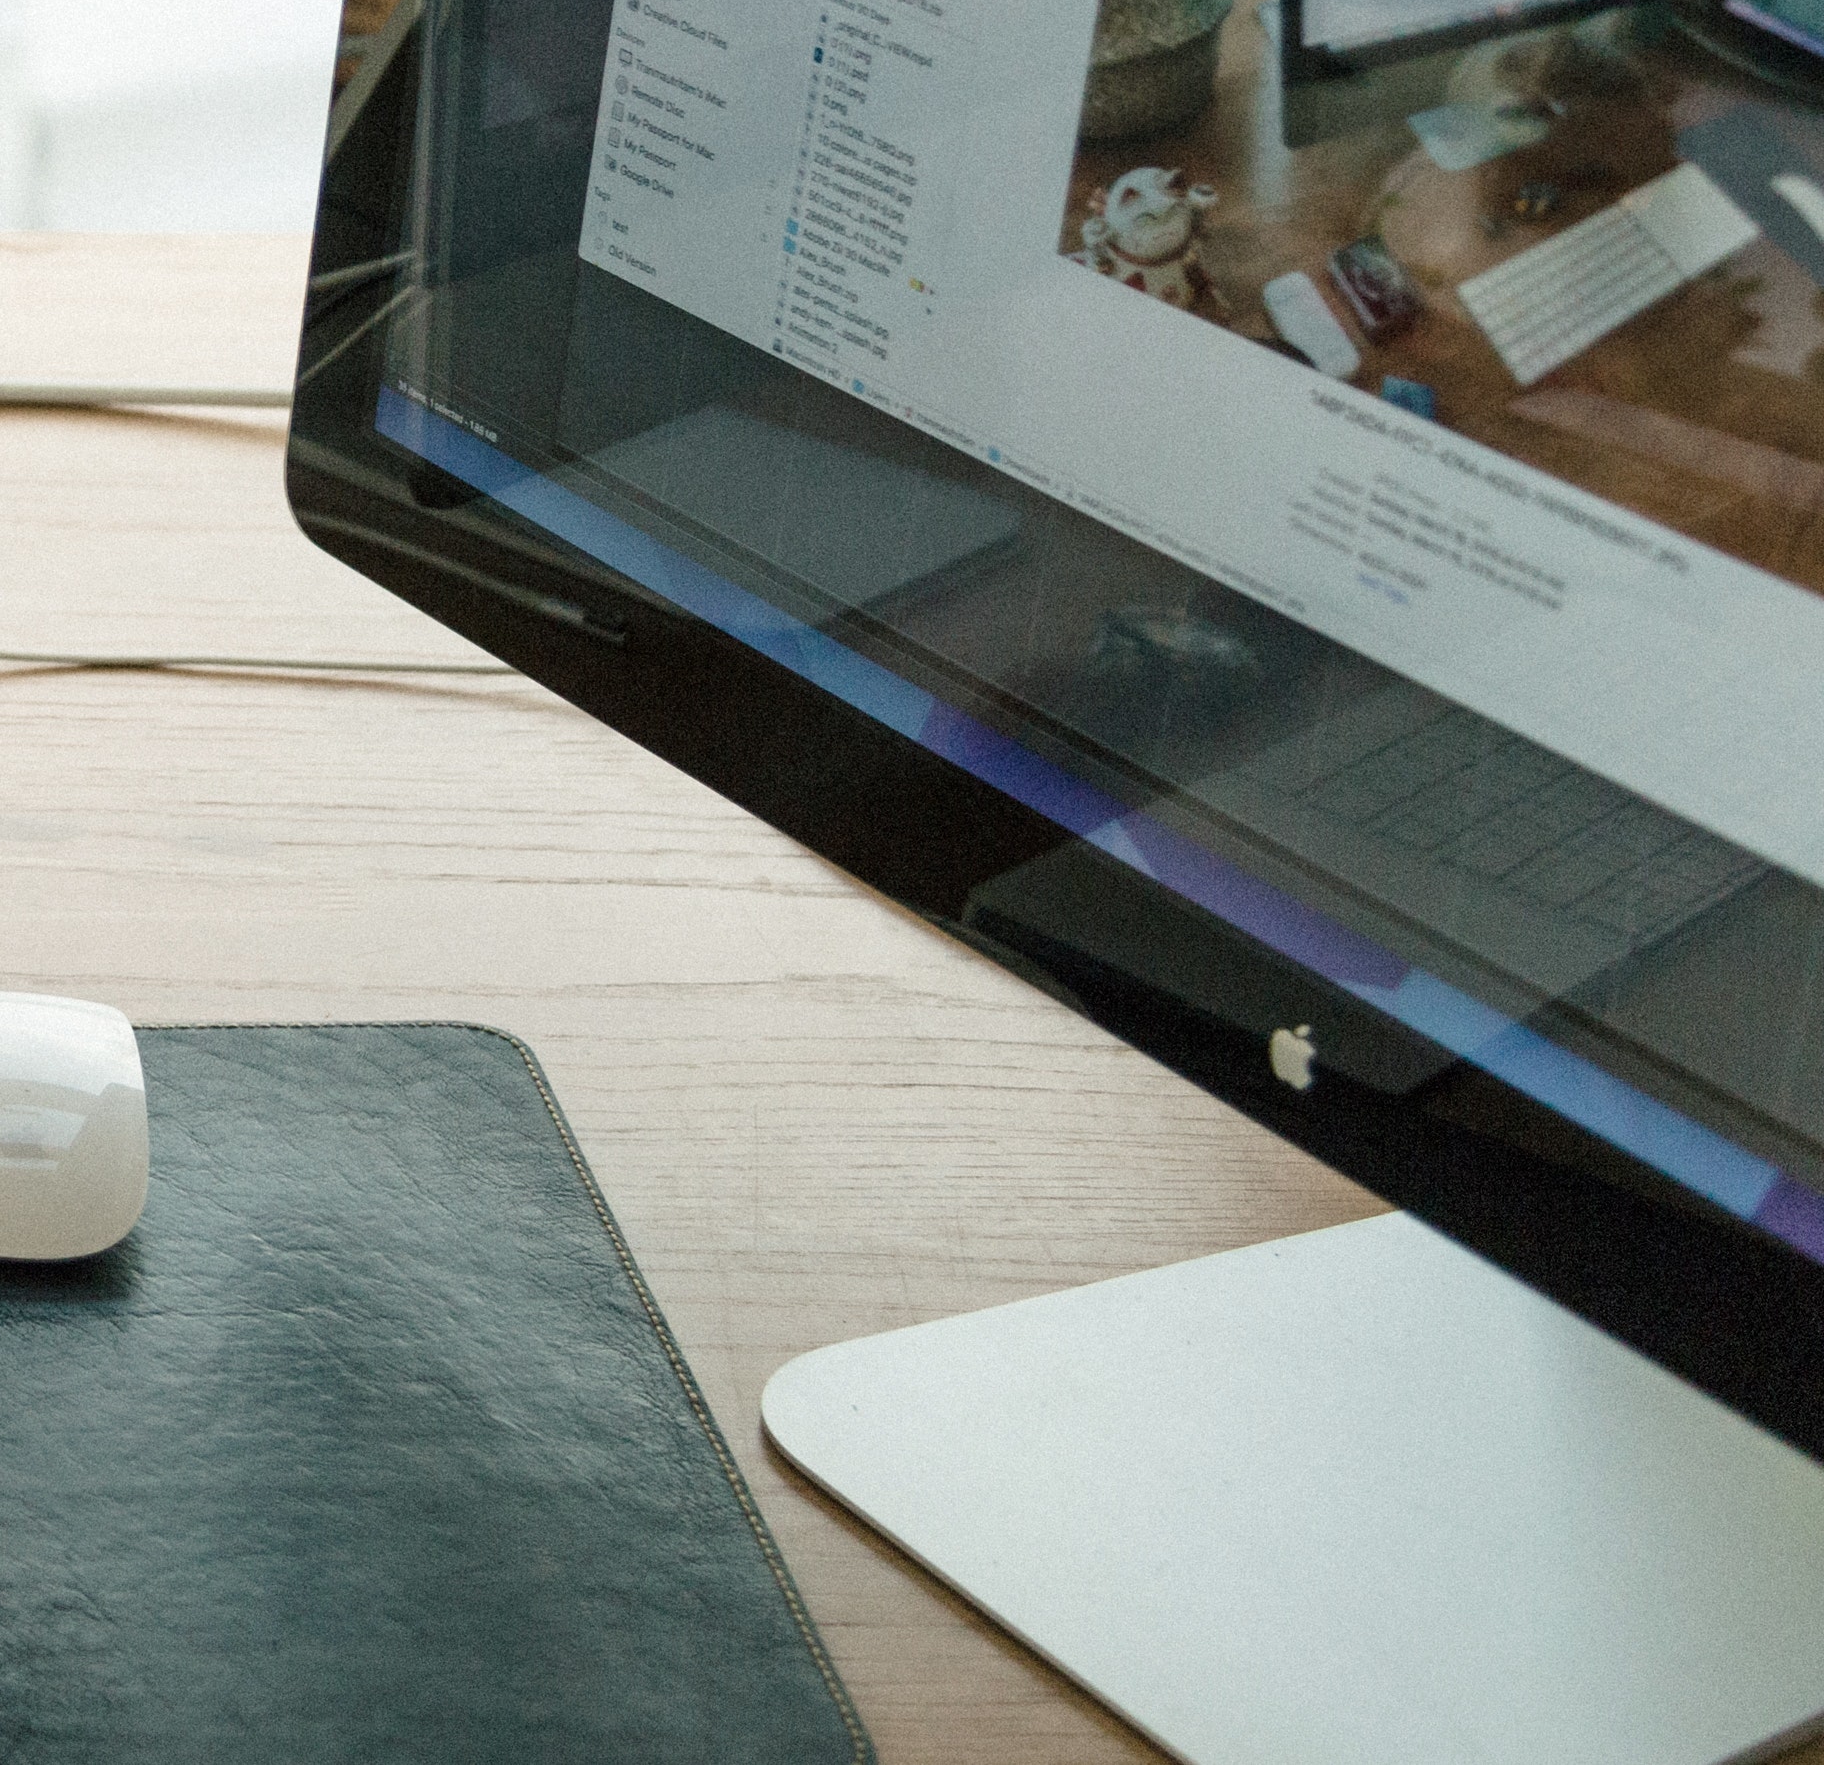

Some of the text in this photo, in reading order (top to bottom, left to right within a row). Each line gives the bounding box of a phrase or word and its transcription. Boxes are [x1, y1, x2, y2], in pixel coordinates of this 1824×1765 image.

[639, 145, 677, 171] Passport
[619, 163, 675, 199] Google Drive
[626, 251, 657, 277] Version
